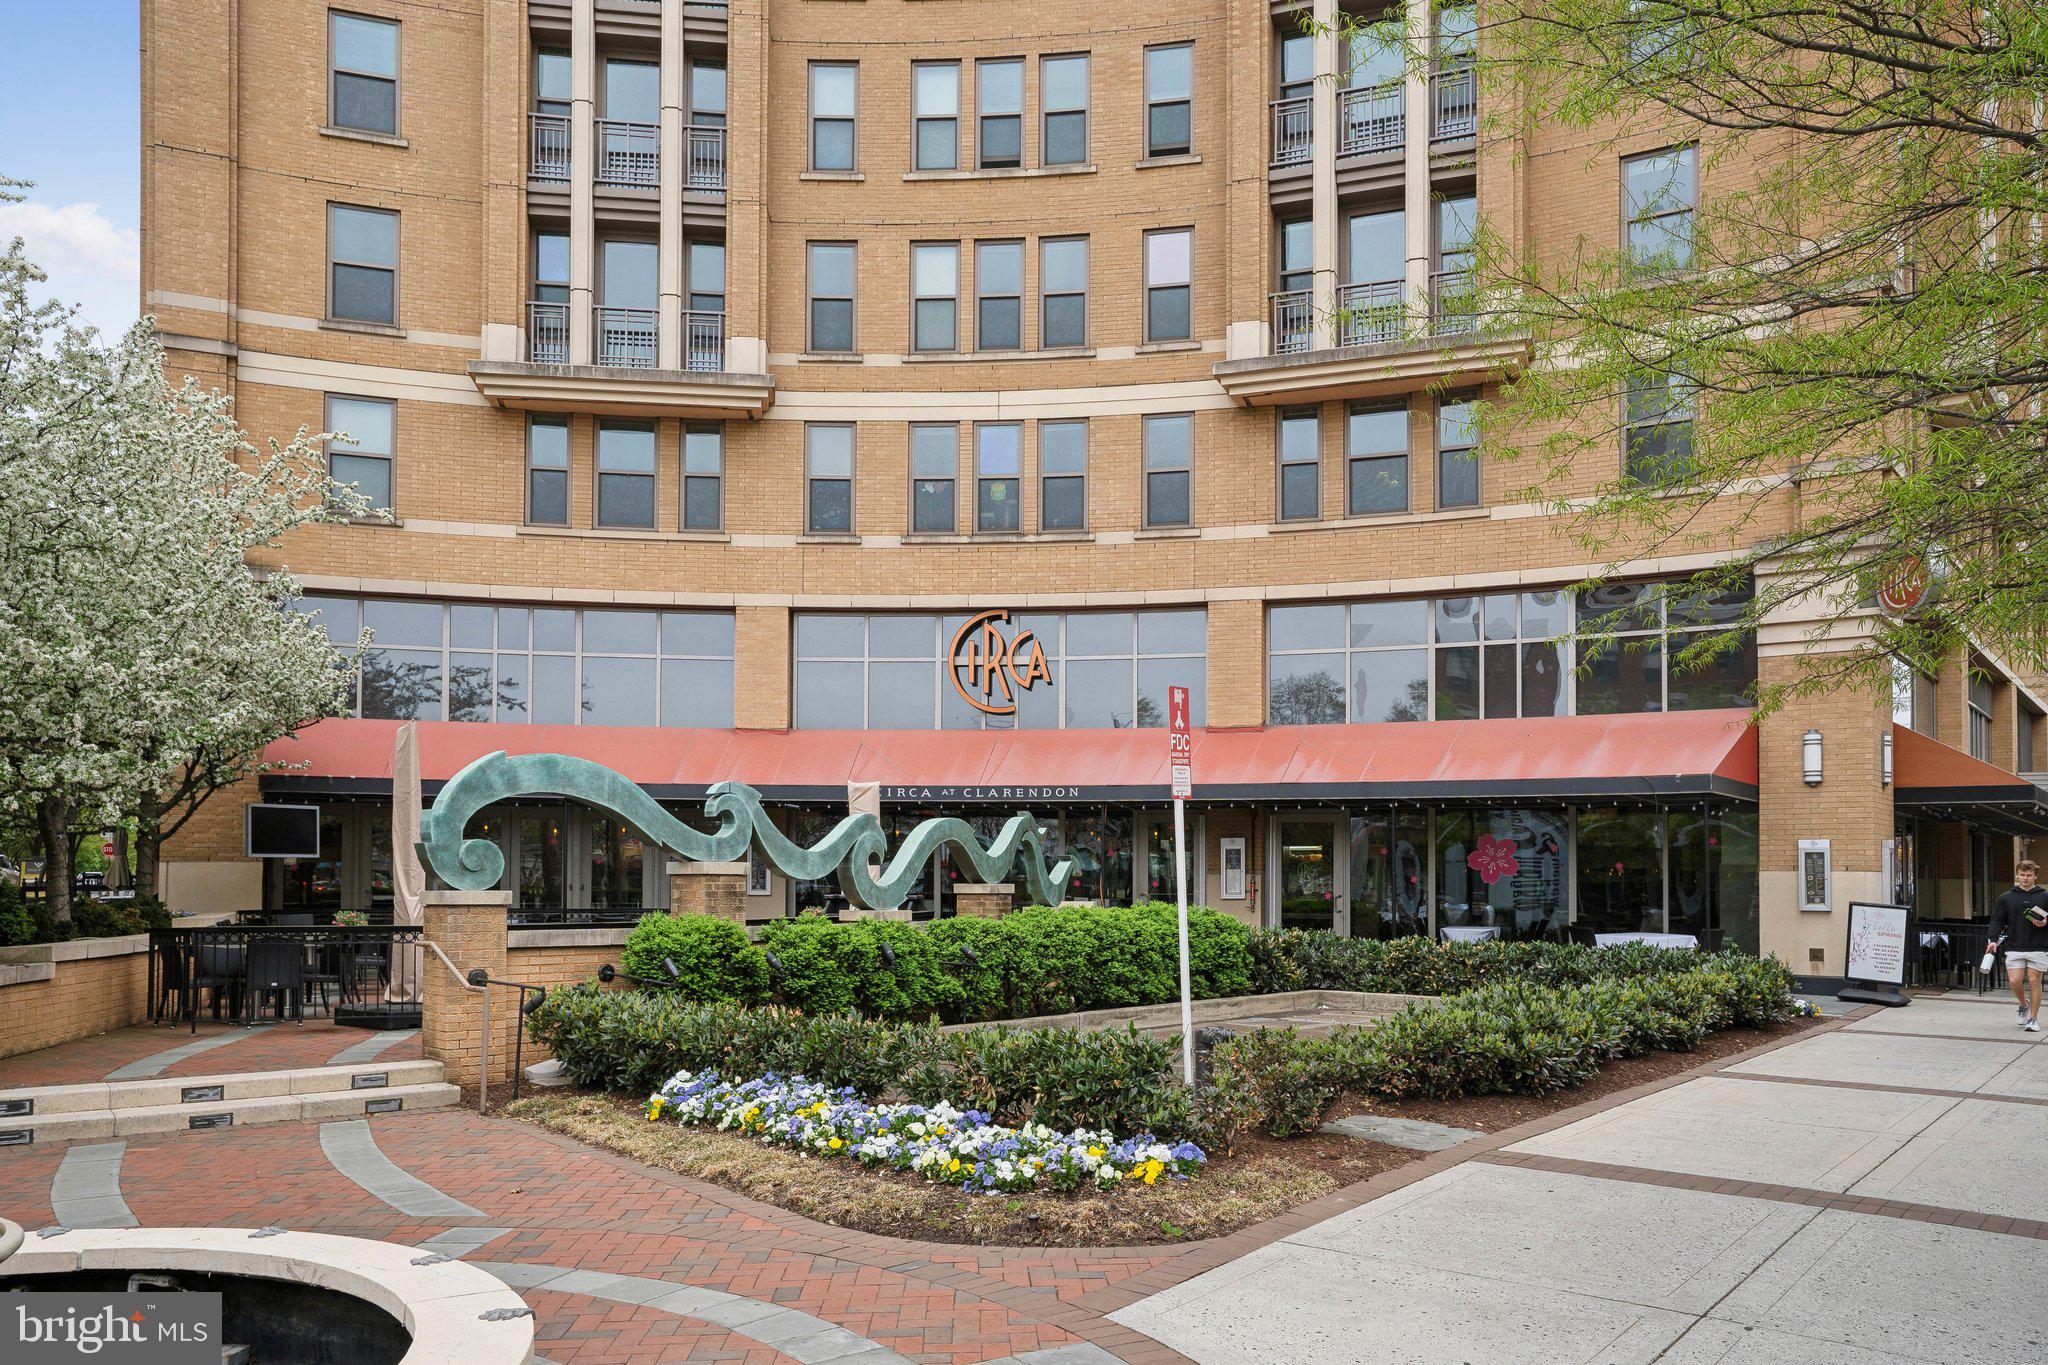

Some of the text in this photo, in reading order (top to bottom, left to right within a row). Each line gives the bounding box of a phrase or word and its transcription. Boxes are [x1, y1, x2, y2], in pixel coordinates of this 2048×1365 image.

[948, 609, 1052, 714] CIRCA
[1171, 733, 1190, 751] FDC
[879, 787, 1080, 798] IRCA AT CLARENDON
